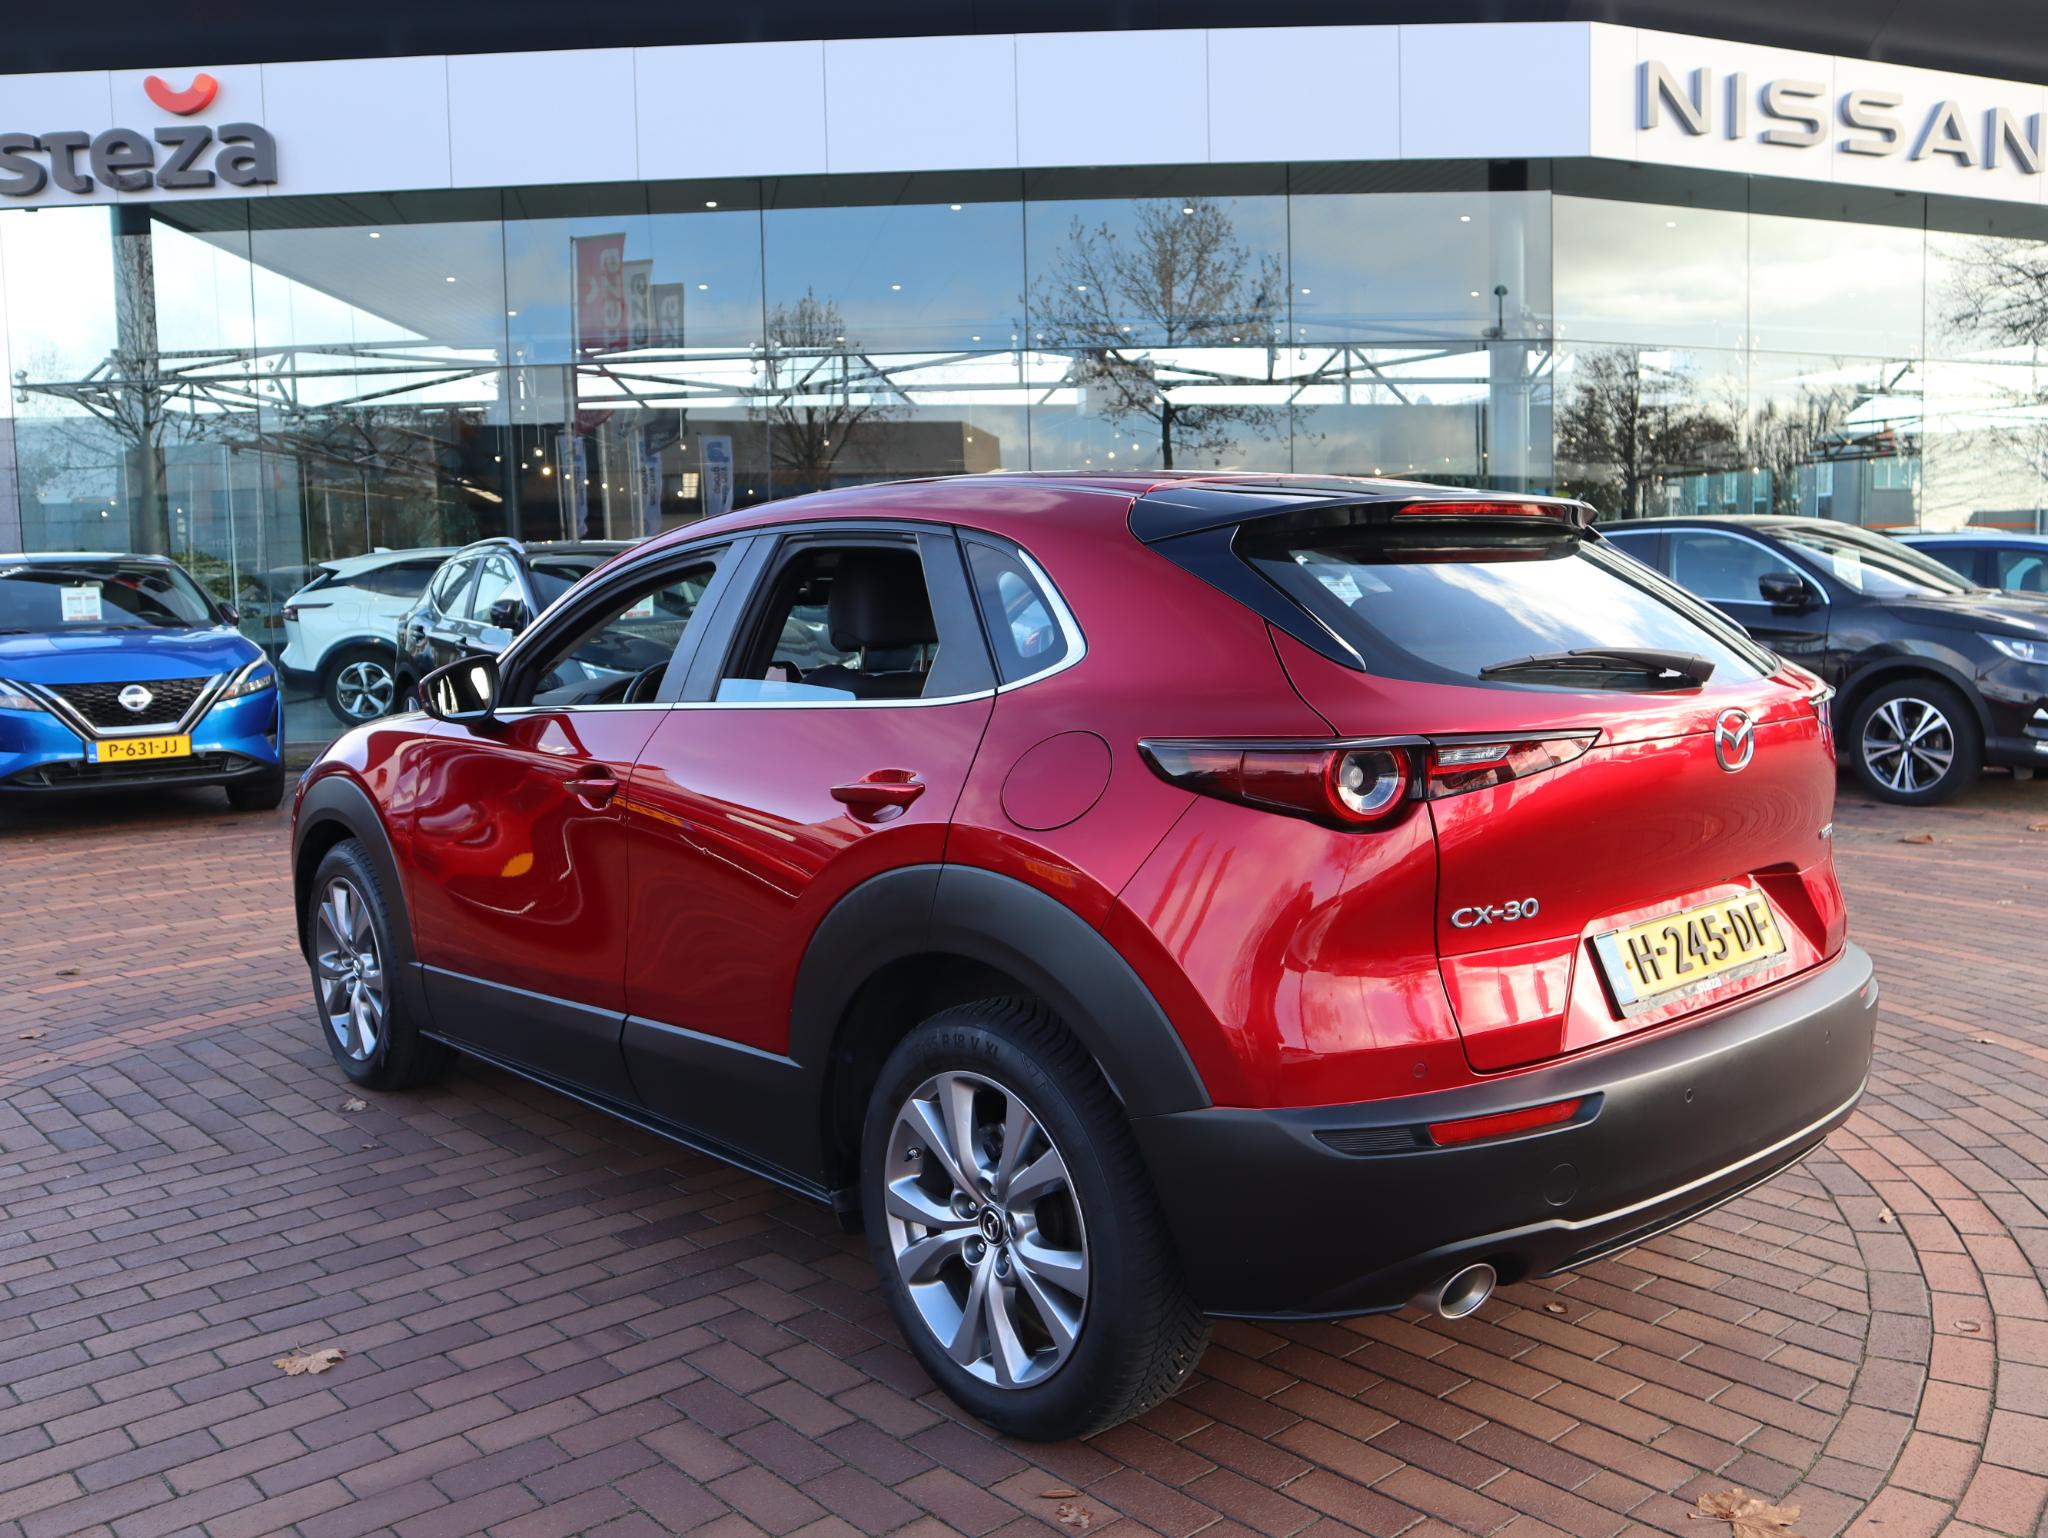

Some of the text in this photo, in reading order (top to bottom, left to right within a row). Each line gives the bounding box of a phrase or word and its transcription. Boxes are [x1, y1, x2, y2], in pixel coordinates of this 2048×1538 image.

[1637, 60, 2047, 174] NISSAN
[0, 123, 278, 197] steza
[109, 739, 178, 758] P-631-JJ
[1451, 898, 1539, 929] CX-30
[1628, 903, 1768, 984] H-245-DF
